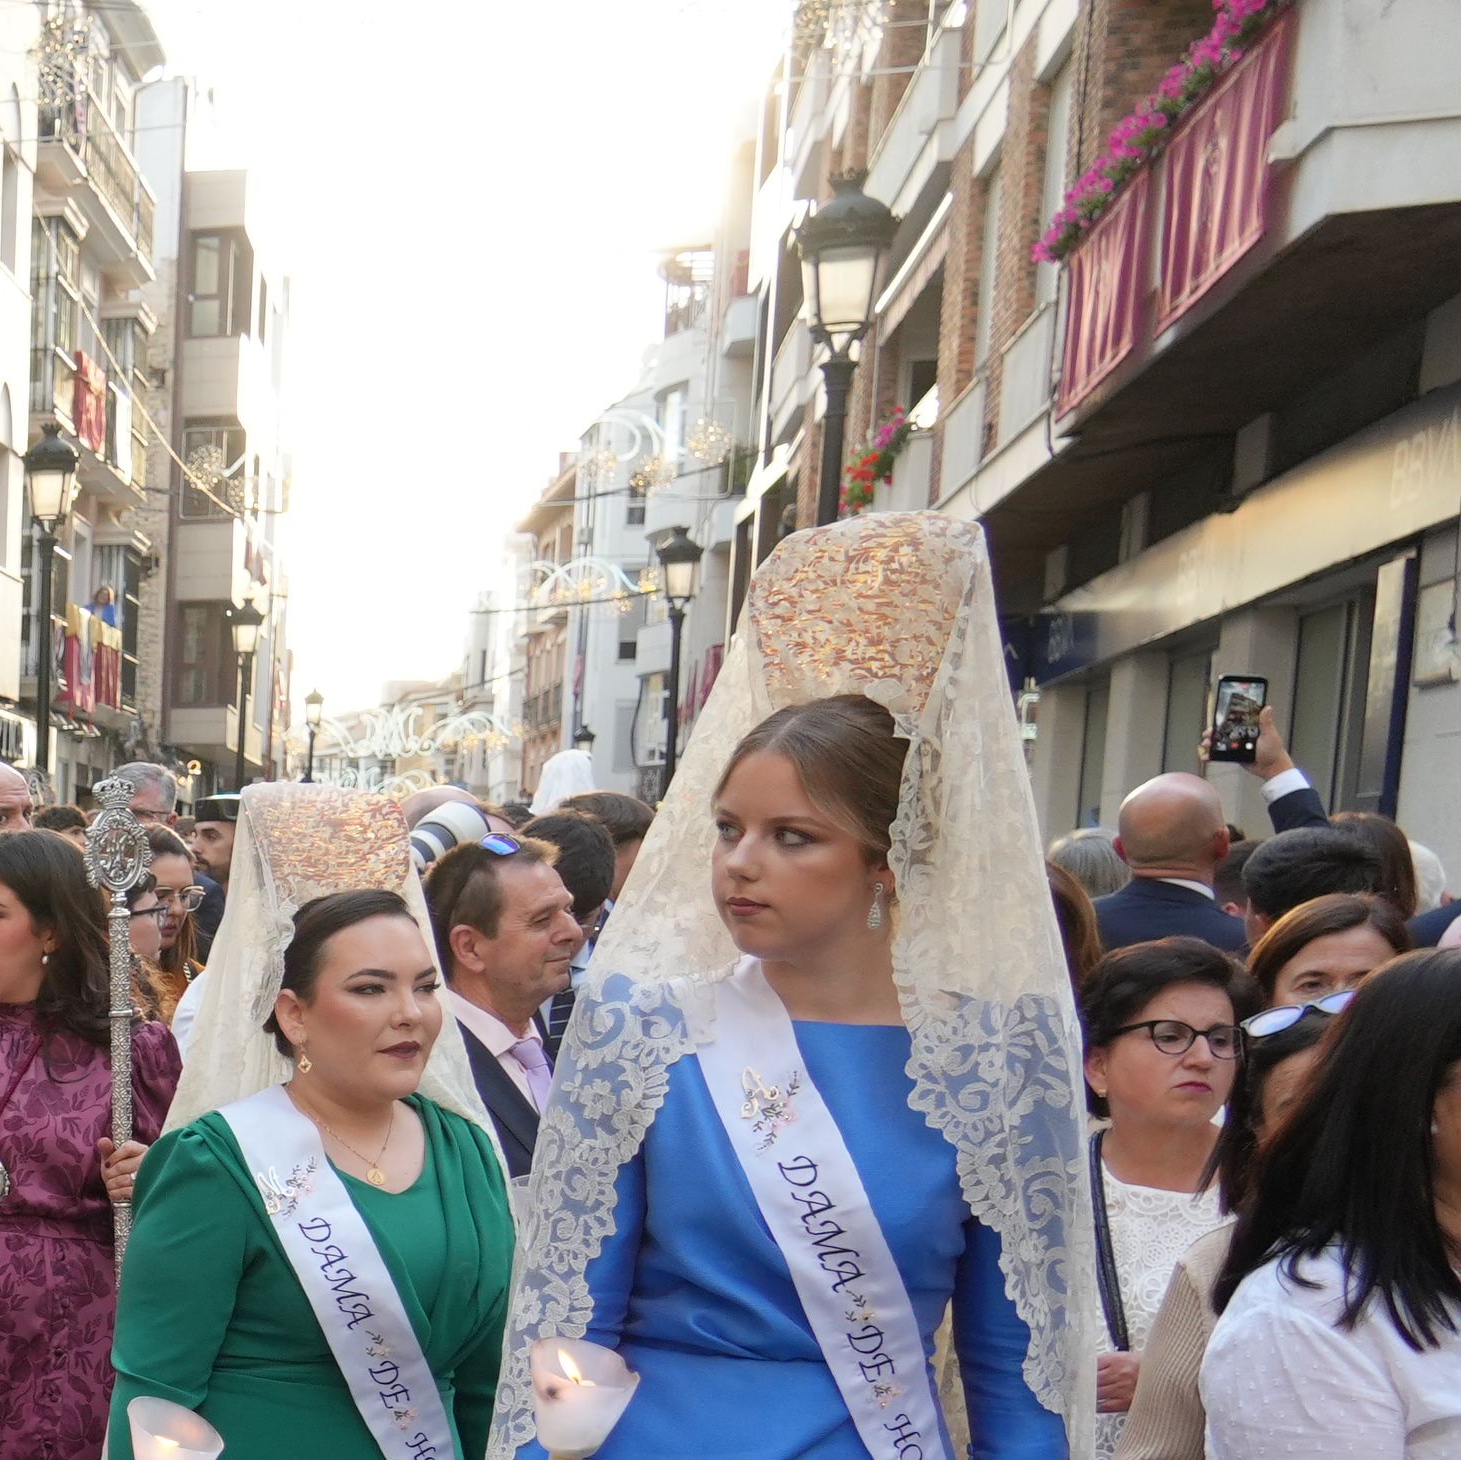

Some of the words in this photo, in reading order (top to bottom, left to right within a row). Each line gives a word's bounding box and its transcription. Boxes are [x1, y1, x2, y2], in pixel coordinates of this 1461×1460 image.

[298, 1216, 375, 1330] DAMA
[368, 1358, 411, 1409] DE
[777, 1155, 866, 1294] DAMA
[846, 1322, 896, 1383] DE
